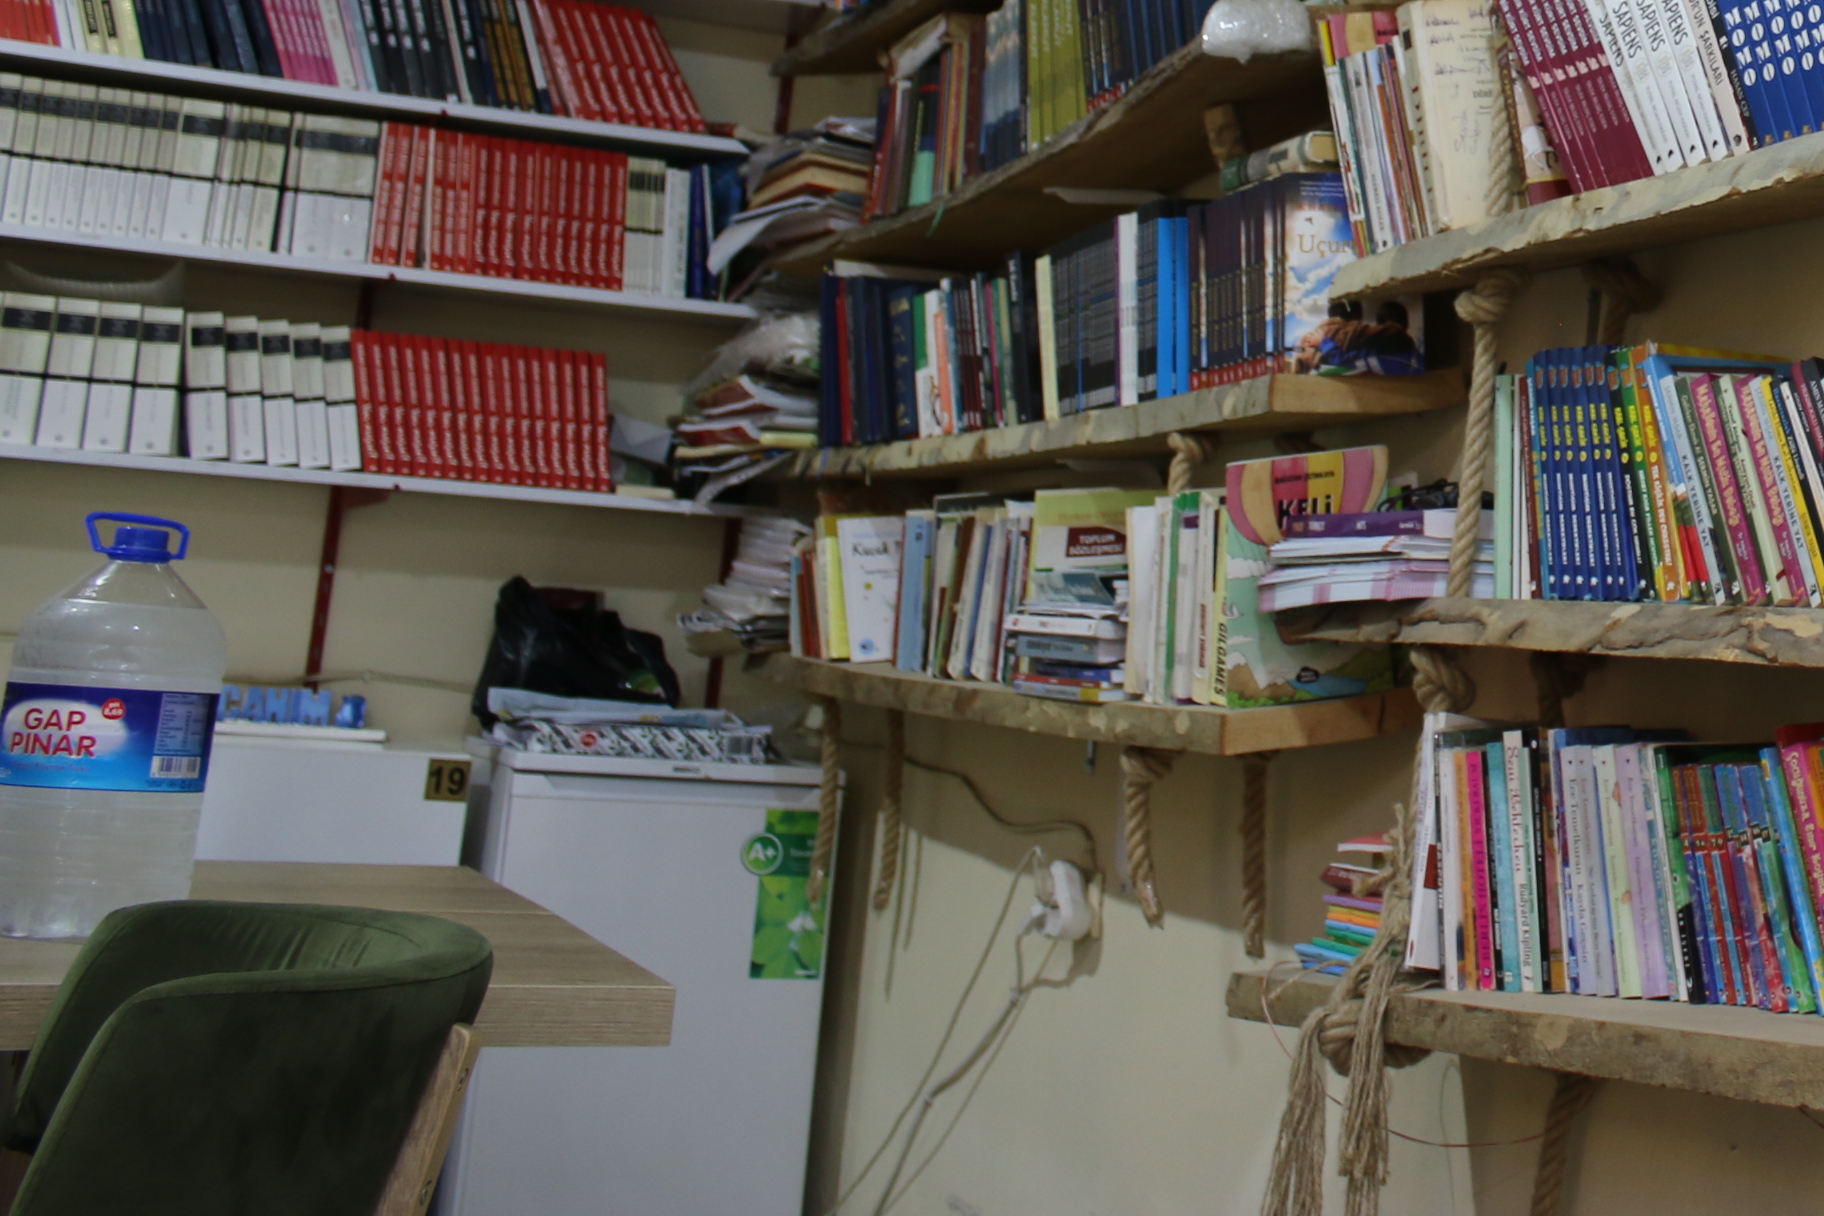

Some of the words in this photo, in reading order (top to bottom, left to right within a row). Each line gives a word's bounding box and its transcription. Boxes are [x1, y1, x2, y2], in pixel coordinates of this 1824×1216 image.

[1699, 31, 1725, 86] ŞARKILARI
[1681, 454, 1693, 480] KALK
[1688, 482, 1705, 525] YERİNE
[1699, 527, 1711, 548] YAT
[24, 708, 87, 732] GAP
[10, 732, 98, 758] PINAR
[430, 765, 467, 796] 19
[745, 842, 778, 860] A+
